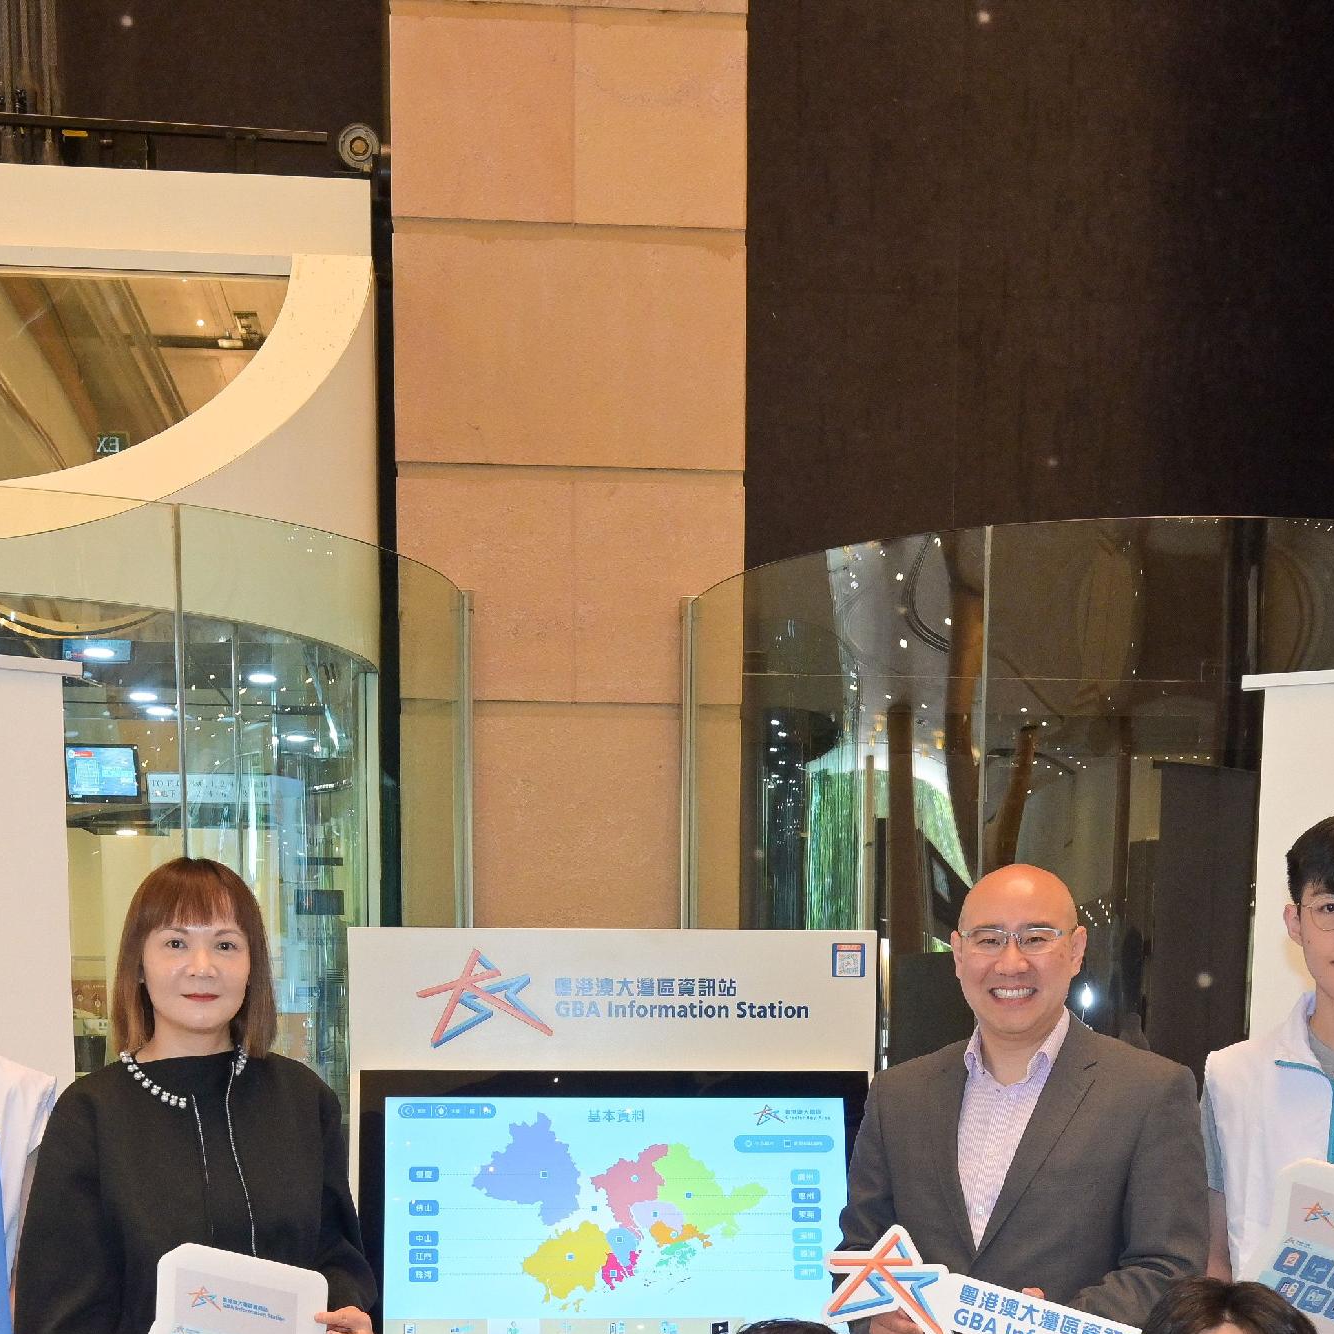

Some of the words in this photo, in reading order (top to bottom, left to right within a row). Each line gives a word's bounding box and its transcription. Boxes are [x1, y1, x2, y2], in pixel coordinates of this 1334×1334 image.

[555, 978, 737, 997] 粵港澳大灣區資訊站
[555, 1001, 600, 1018] GBA
[608, 1000, 729, 1018] Information
[736, 1000, 809, 1018] Station
[588, 1109, 645, 1122] 基本資料
[416, 1234, 432, 1242] 中山
[954, 1308, 997, 1334] GBA
